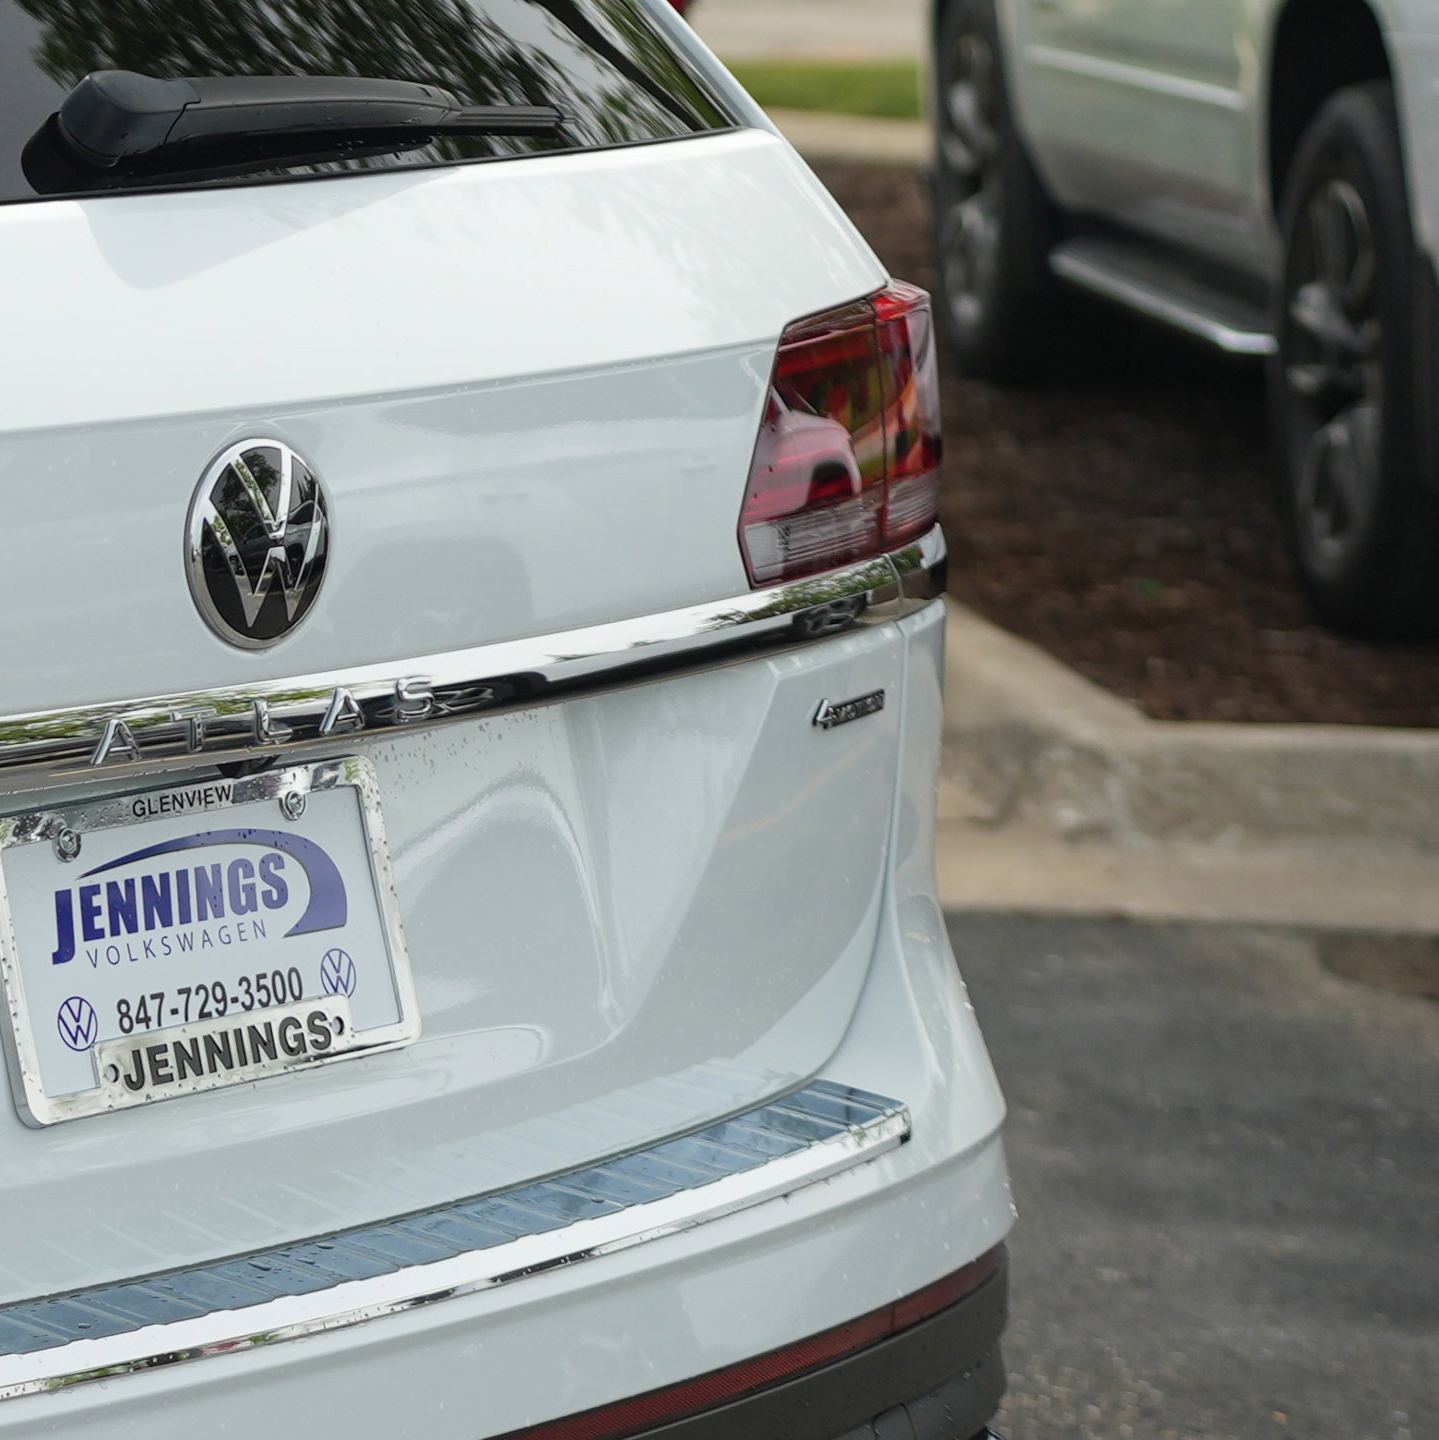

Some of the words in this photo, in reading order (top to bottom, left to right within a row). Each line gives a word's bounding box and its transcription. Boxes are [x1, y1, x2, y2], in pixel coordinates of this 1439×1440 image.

[187, 440, 329, 644] VW
[91, 674, 435, 766] ATLAS
[131, 783, 233, 818] GLENVIEW
[51, 852, 290, 965] JENNINGS
[86, 918, 267, 969] VOLKSWAGEN
[57, 996, 98, 1052] VW
[116, 966, 303, 1034] 847-729-3500
[123, 1010, 333, 1091] JENNINGS
